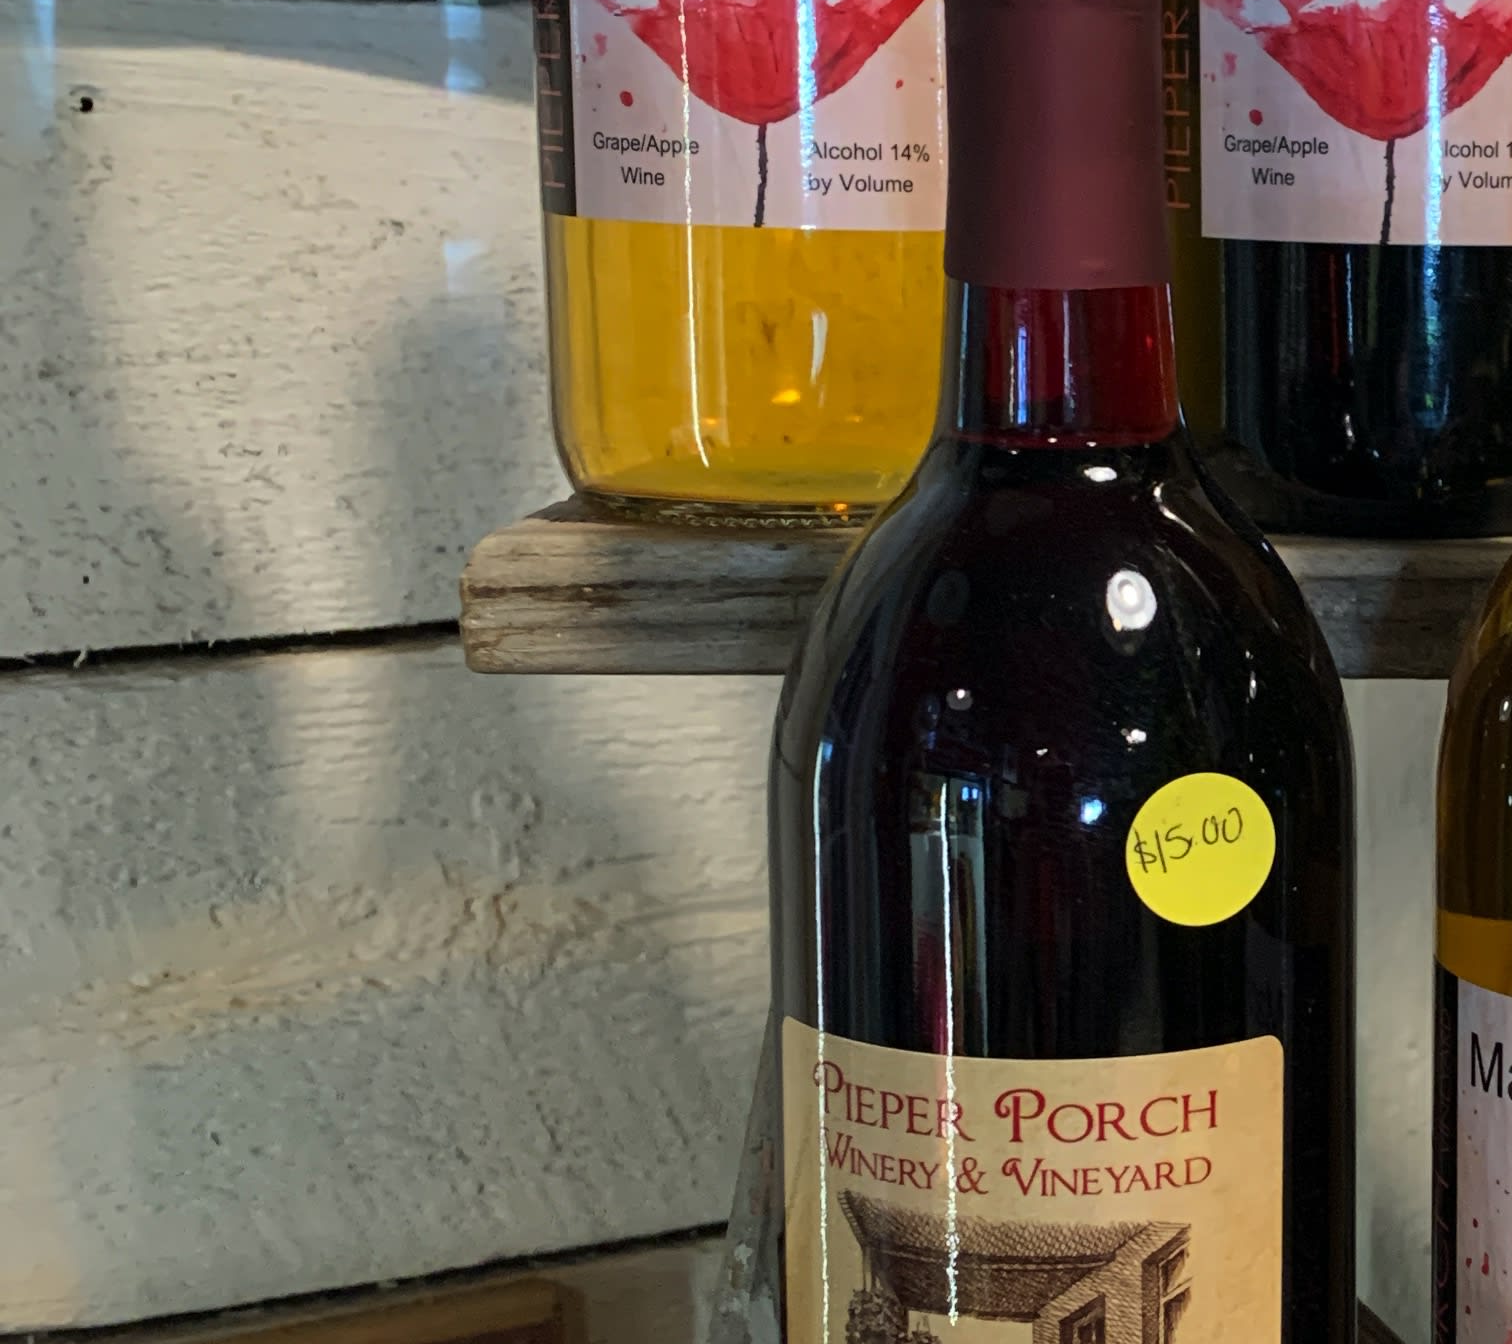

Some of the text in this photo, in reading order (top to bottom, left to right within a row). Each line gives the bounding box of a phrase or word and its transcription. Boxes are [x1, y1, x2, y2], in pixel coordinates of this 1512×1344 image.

[1160, 6, 1192, 210] PIEPER
[592, 131, 700, 159] Grape/Apple
[808, 141, 931, 163] Alcohol 14%
[1224, 134, 1329, 158] Grape/Apple
[1438, 140, 1499, 160] lcohol
[620, 166, 665, 187] Wine
[808, 173, 914, 196] by Volume
[1252, 167, 1296, 187] Wine
[1133, 806, 1243, 874] $15.00
[813, 1060, 1218, 1144] PIEPER PORCH
[821, 1126, 1212, 1196] WINERY & VINEYARD
